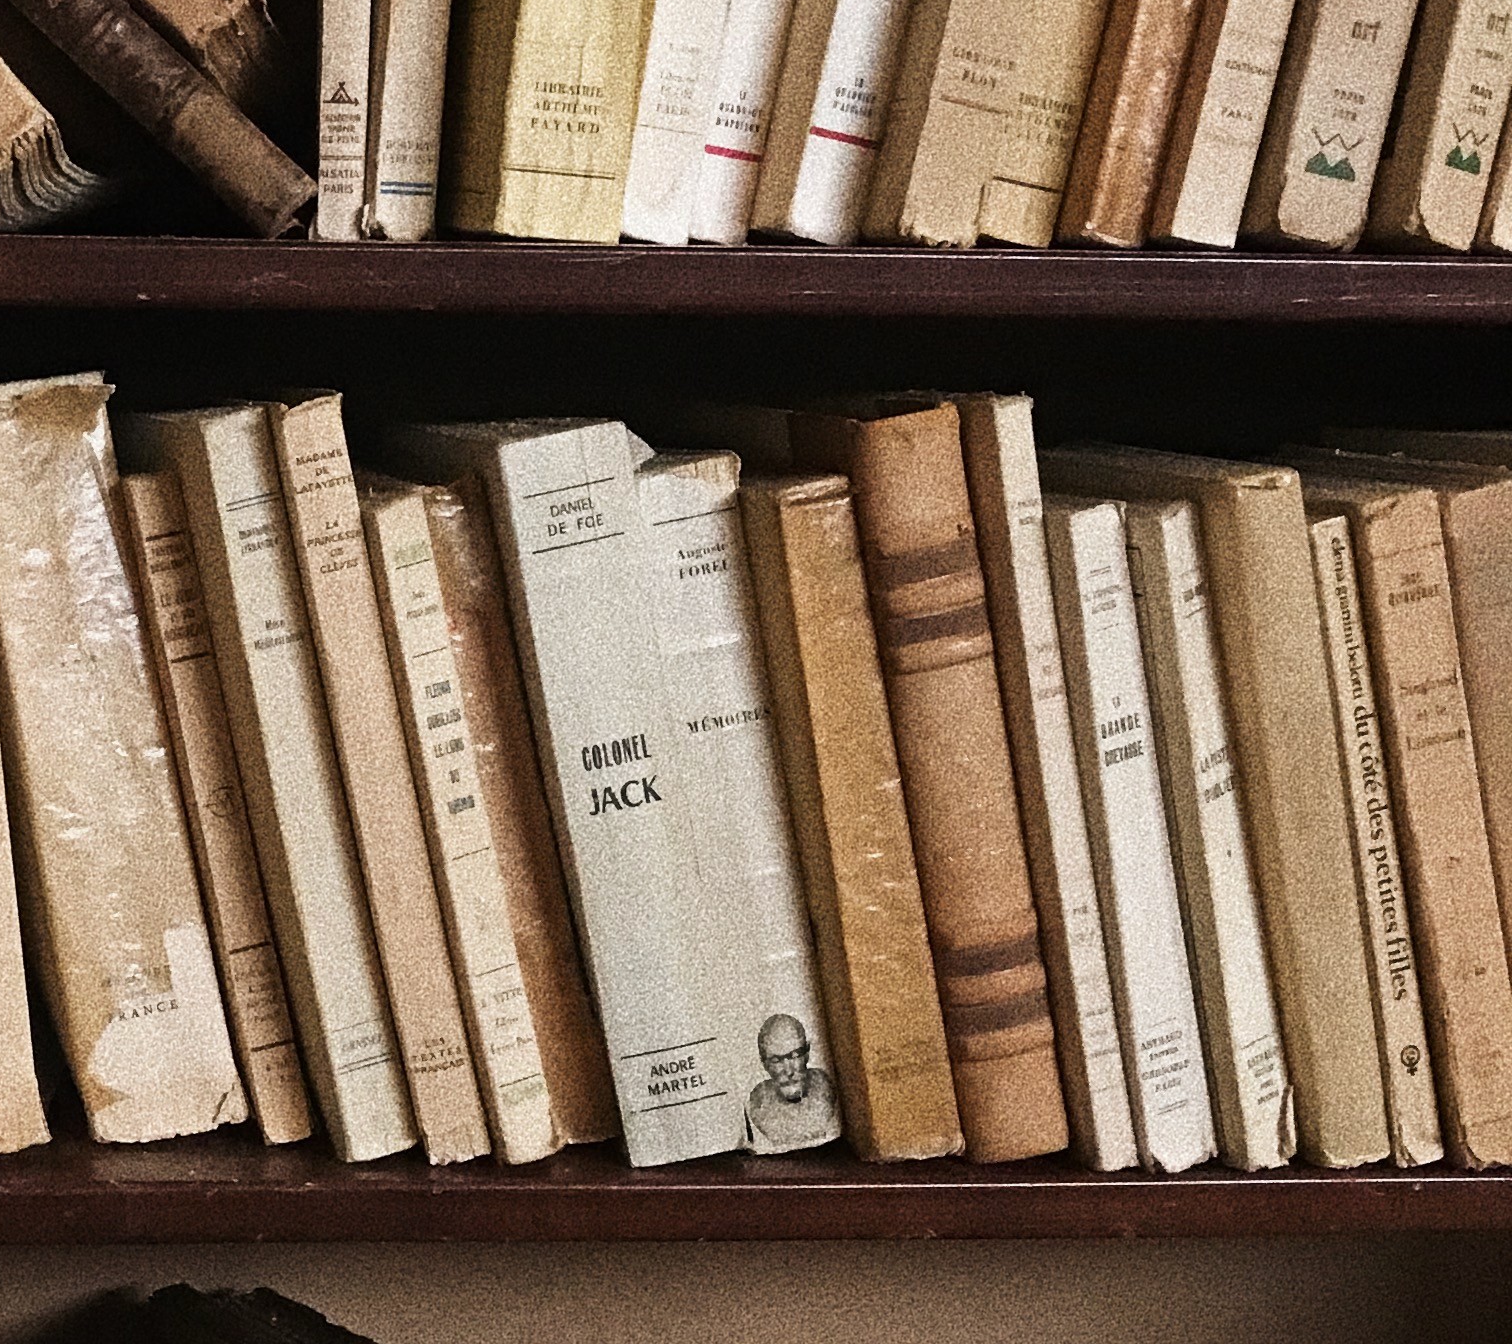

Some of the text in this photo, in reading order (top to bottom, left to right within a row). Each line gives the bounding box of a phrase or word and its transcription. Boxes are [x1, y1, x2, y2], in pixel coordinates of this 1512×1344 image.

[530, 118, 600, 134] FAYARD
[323, 184, 354, 194] PARIS
[547, 514, 604, 537] DE FOE
[549, 498, 596, 517] DANIEL
[1330, 536, 1345, 582] elena
[1354, 705, 1377, 738] du
[582, 733, 652, 772] COLONEL
[1358, 741, 1384, 796] côté
[589, 775, 662, 816] JACK
[1366, 796, 1387, 842] des
[1367, 843, 1400, 935] petites
[1385, 935, 1411, 1002] filles
[647, 1074, 707, 1097] MARTEL
[648, 1057, 697, 1078] ANDRÉ
